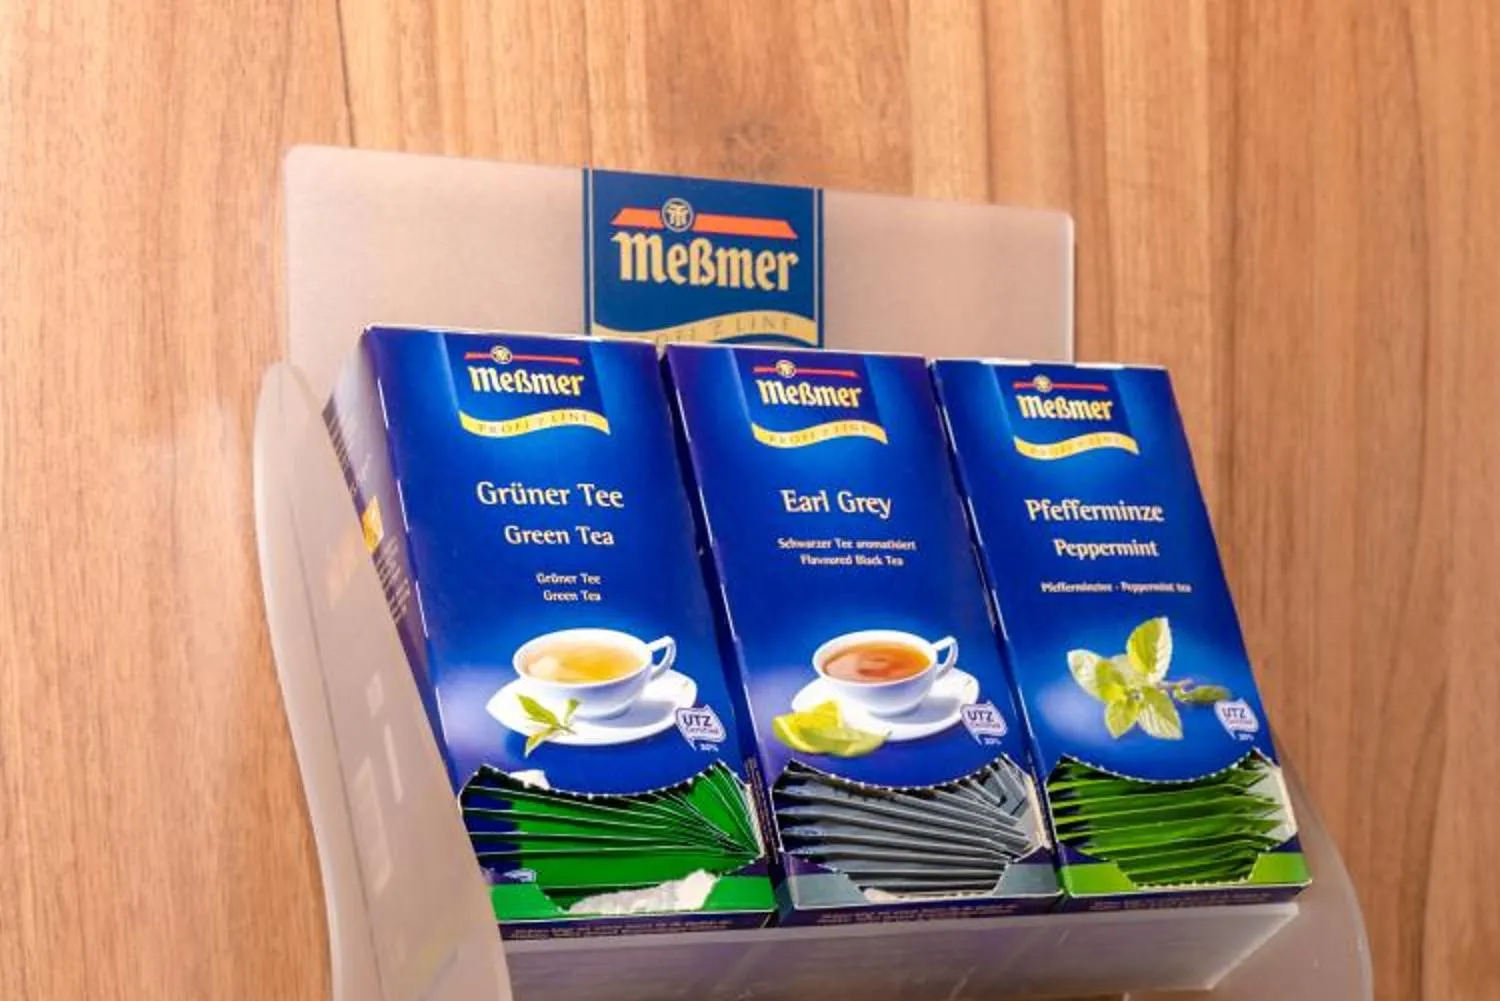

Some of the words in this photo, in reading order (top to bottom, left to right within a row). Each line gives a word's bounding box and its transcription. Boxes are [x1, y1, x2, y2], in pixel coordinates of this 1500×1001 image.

[611, 231, 799, 291] Meßmer
[468, 366, 585, 396] Meßmer
[755, 379, 862, 408] Meßmer
[1016, 395, 1114, 420] Meßmer
[476, 480, 571, 506] Grüner
[576, 482, 625, 509] Tee
[780, 489, 830, 513] Earl
[837, 490, 893, 520] Grey
[1024, 499, 1165, 522] Pfefferminze
[503, 524, 571, 545] Green
[575, 525, 616, 546] Tea
[1053, 538, 1160, 561] Peppermint
[682, 713, 712, 727] UTZ
[967, 709, 994, 722] UTZ
